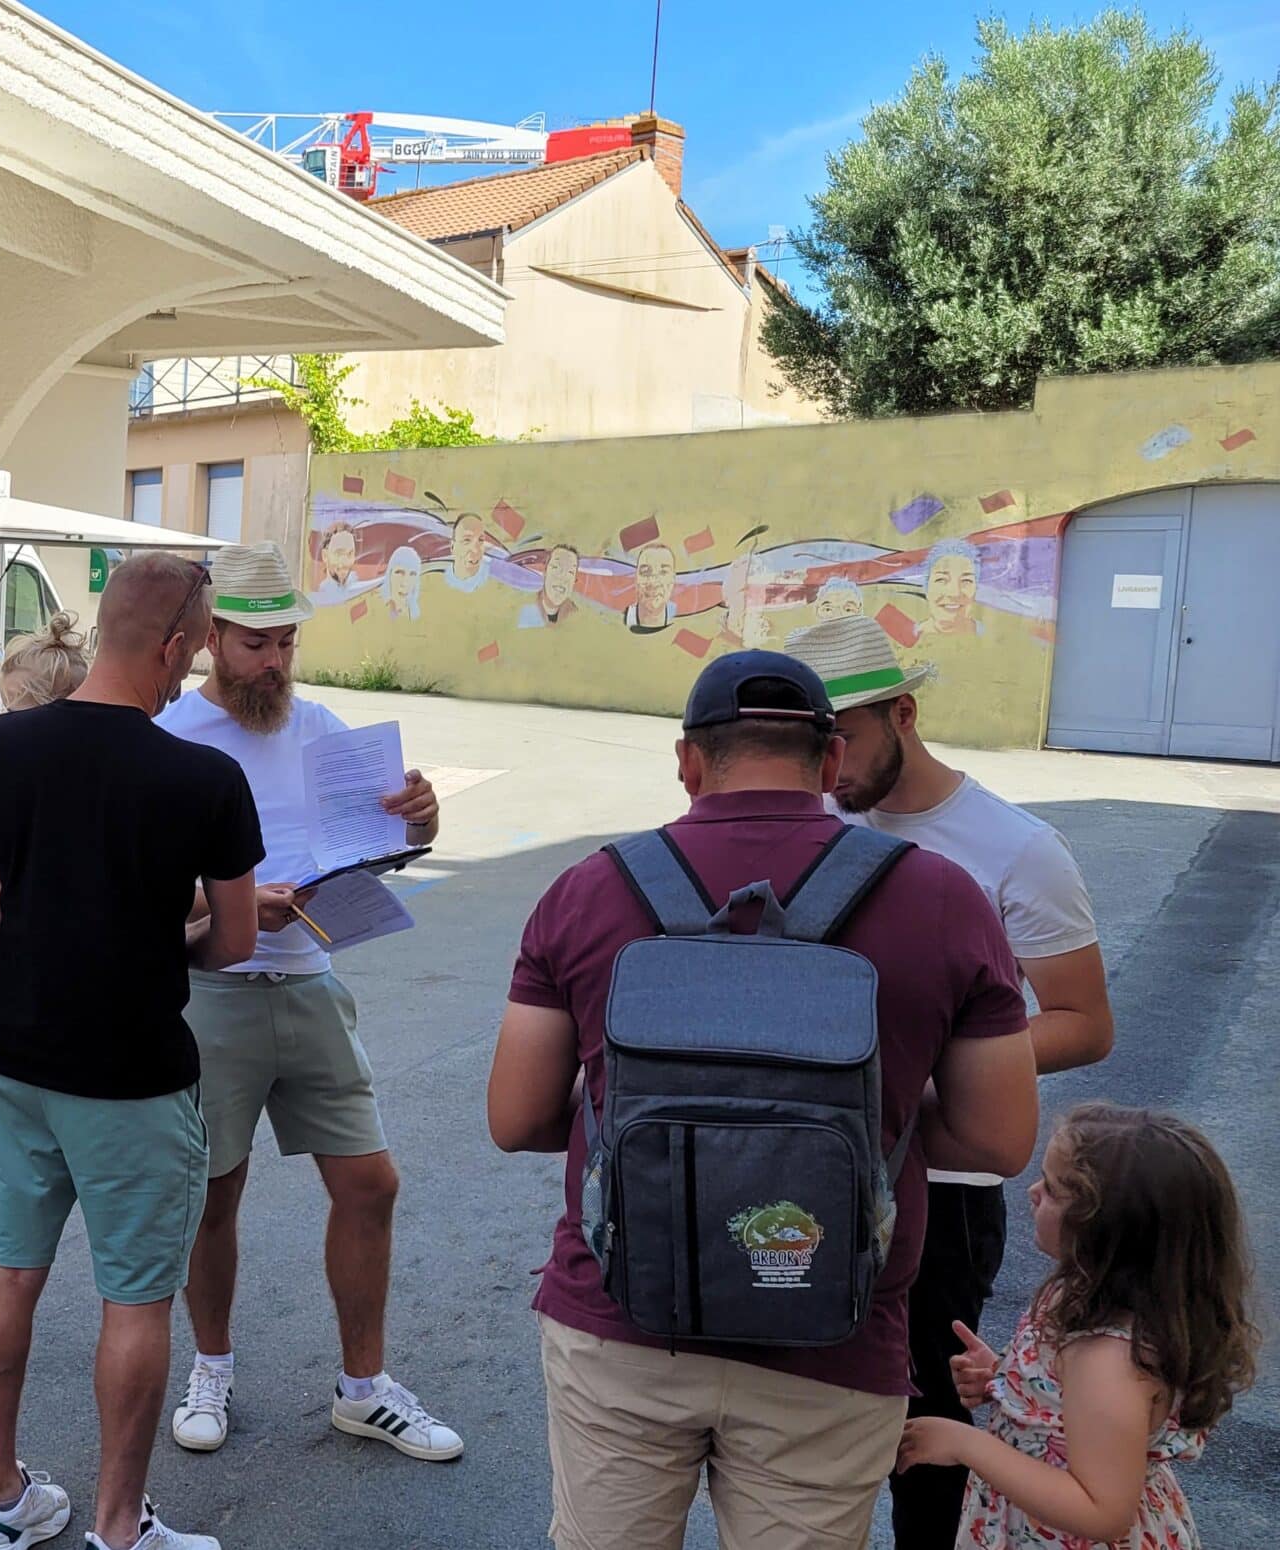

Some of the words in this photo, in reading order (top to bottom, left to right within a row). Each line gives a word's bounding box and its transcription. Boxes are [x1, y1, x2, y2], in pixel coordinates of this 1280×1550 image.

[463, 151, 484, 160] SAINT
[487, 151, 504, 160] YVES
[508, 150, 542, 160] SERVICES
[751, 1249, 813, 1266] ARBORYS
